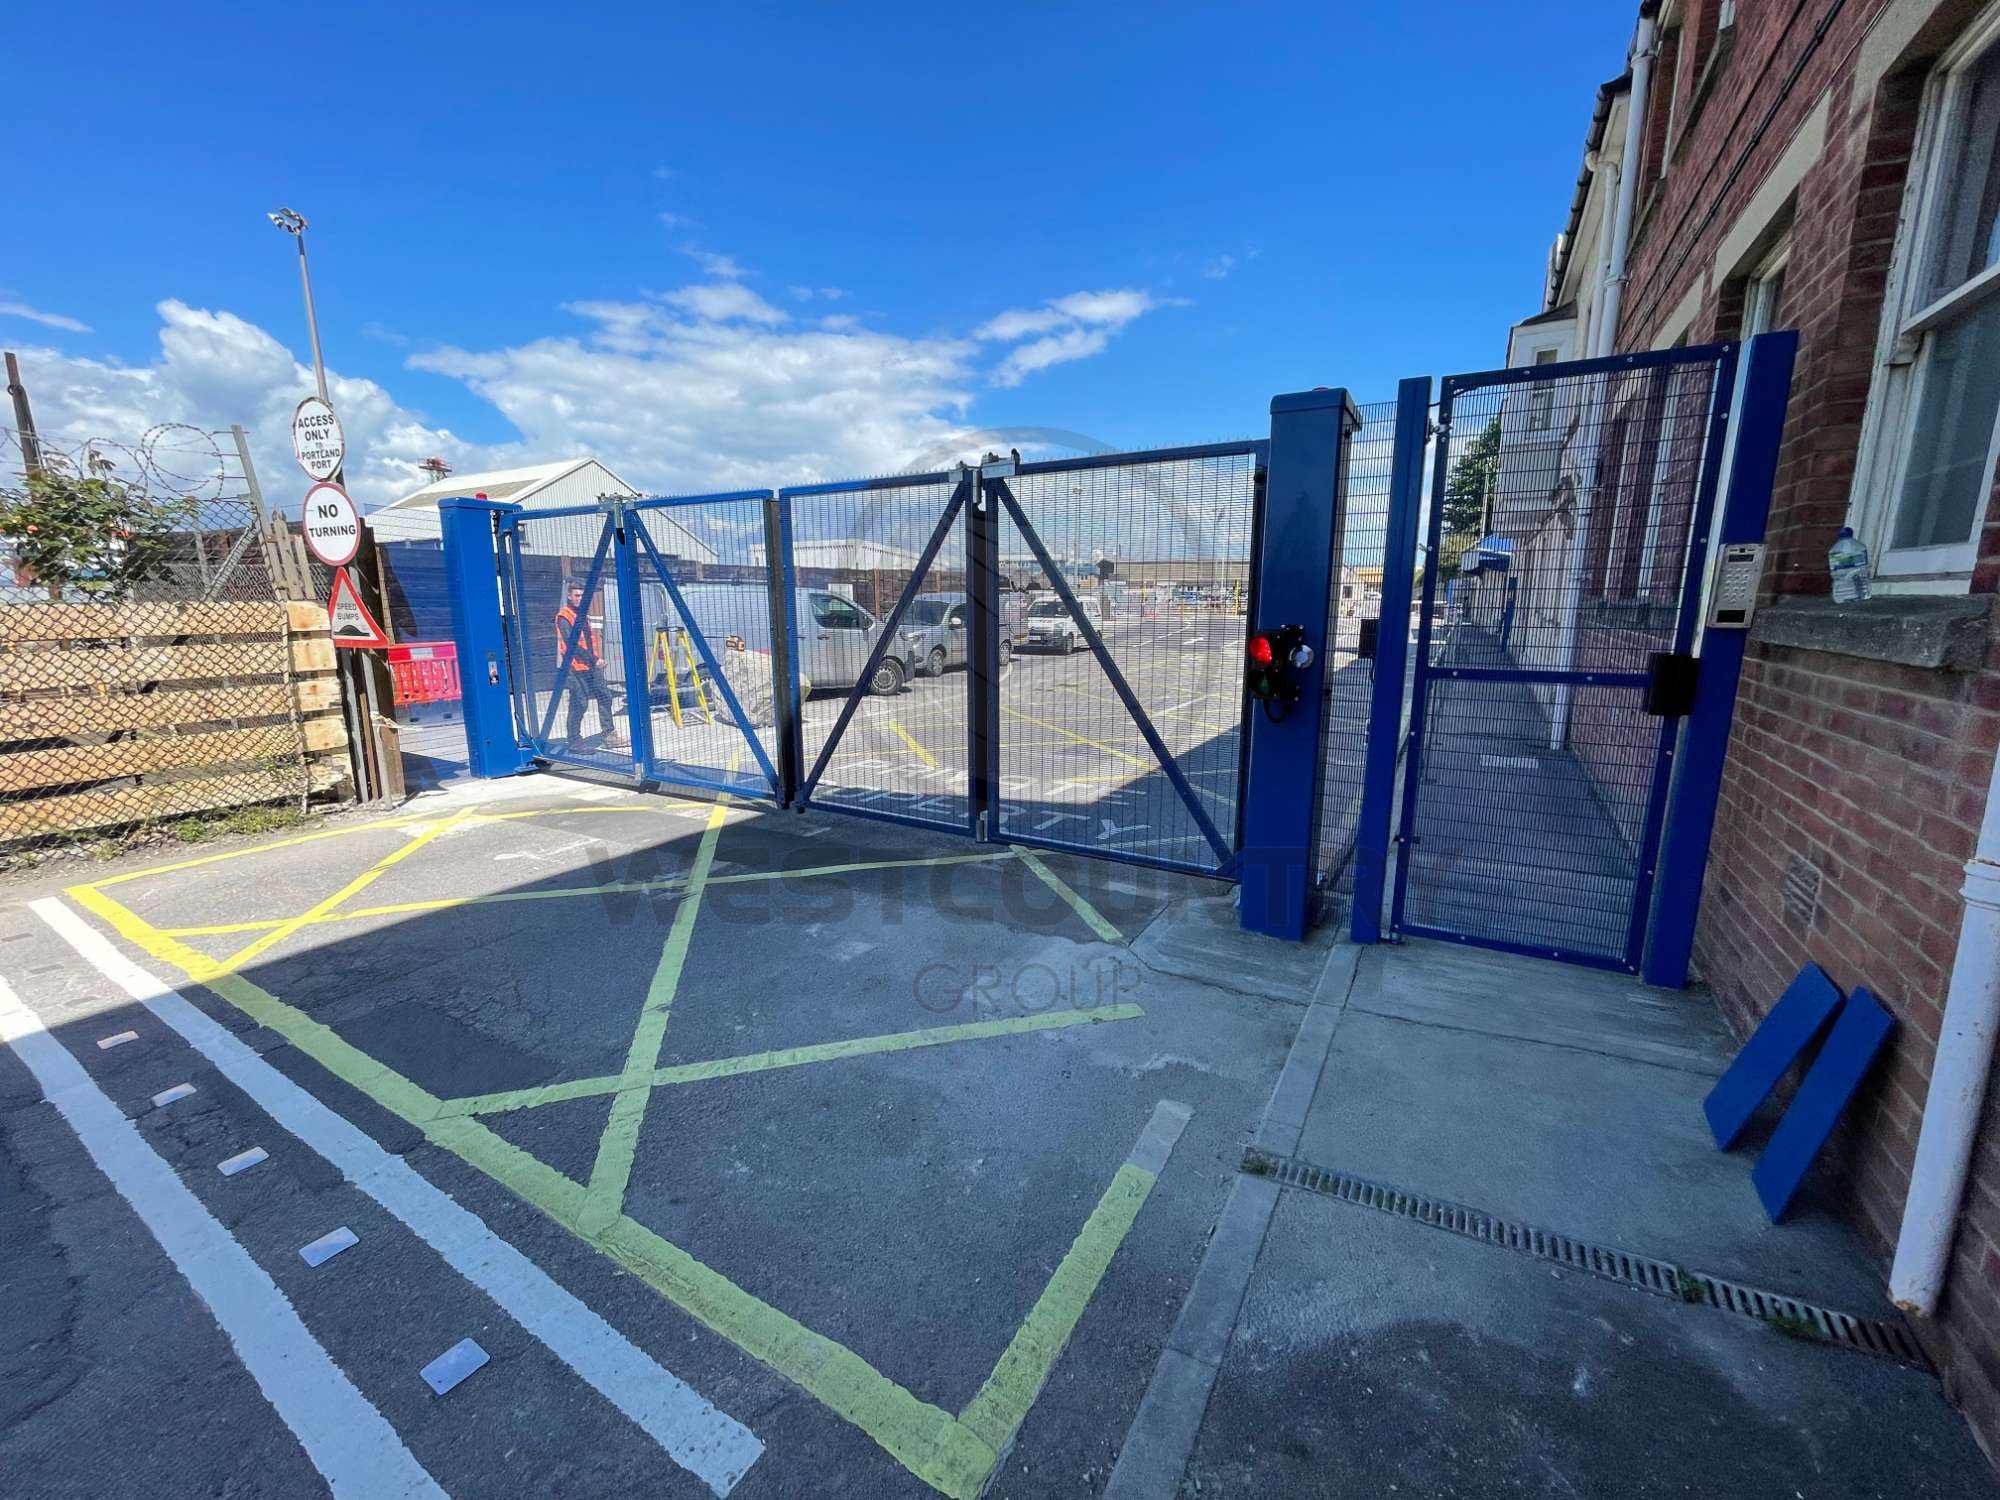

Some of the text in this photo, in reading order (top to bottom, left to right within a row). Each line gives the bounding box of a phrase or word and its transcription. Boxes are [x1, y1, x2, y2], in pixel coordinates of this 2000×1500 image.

[298, 414, 335, 429] ACCESS
[304, 428, 330, 441] ONLY
[301, 448, 341, 460] PORTLAND
[311, 460, 331, 470] PORT
[318, 504, 338, 518] NO
[308, 524, 356, 538] TURNING
[336, 602, 357, 611] SPEED
[336, 612, 360, 621] BUMPS
